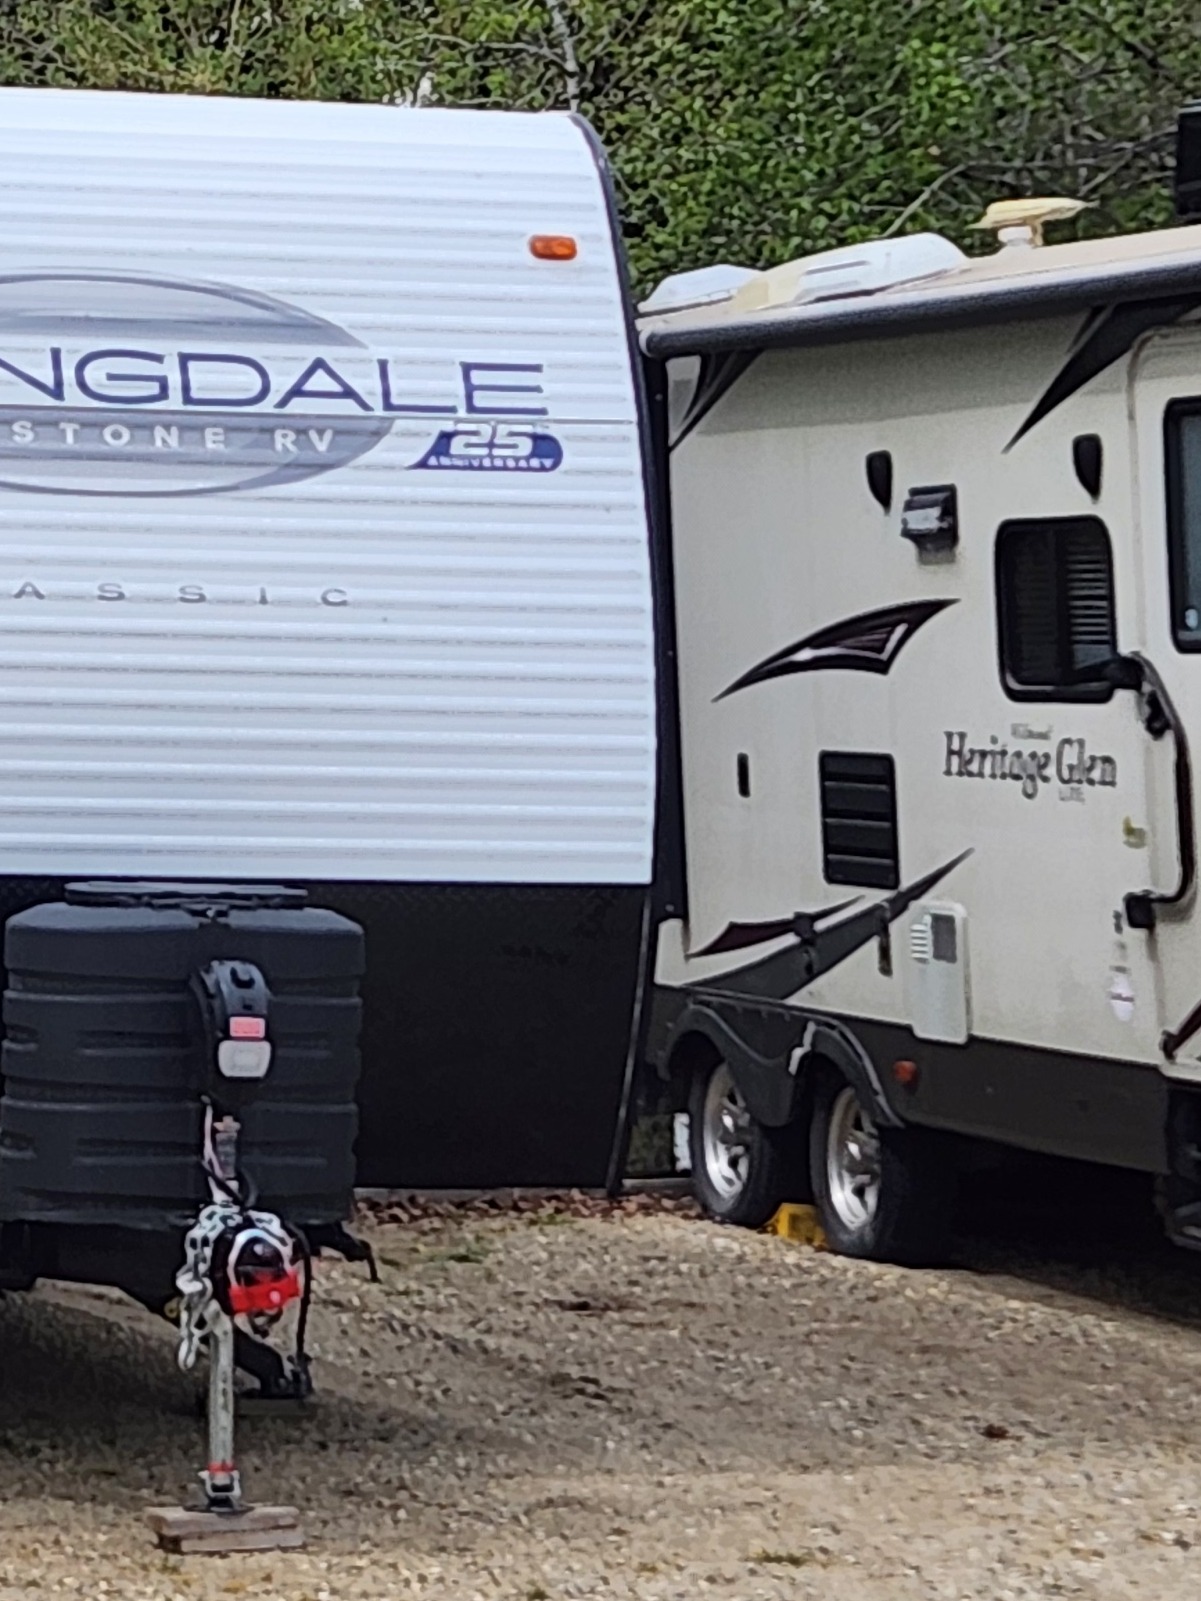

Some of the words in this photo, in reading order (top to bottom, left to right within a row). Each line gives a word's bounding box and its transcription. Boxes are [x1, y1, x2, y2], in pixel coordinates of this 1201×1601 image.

[273, 427, 336, 454] RV
[449, 422, 534, 457] 25
[942, 730, 1051, 800] Heritage
[1055, 737, 1118, 788] Glen
